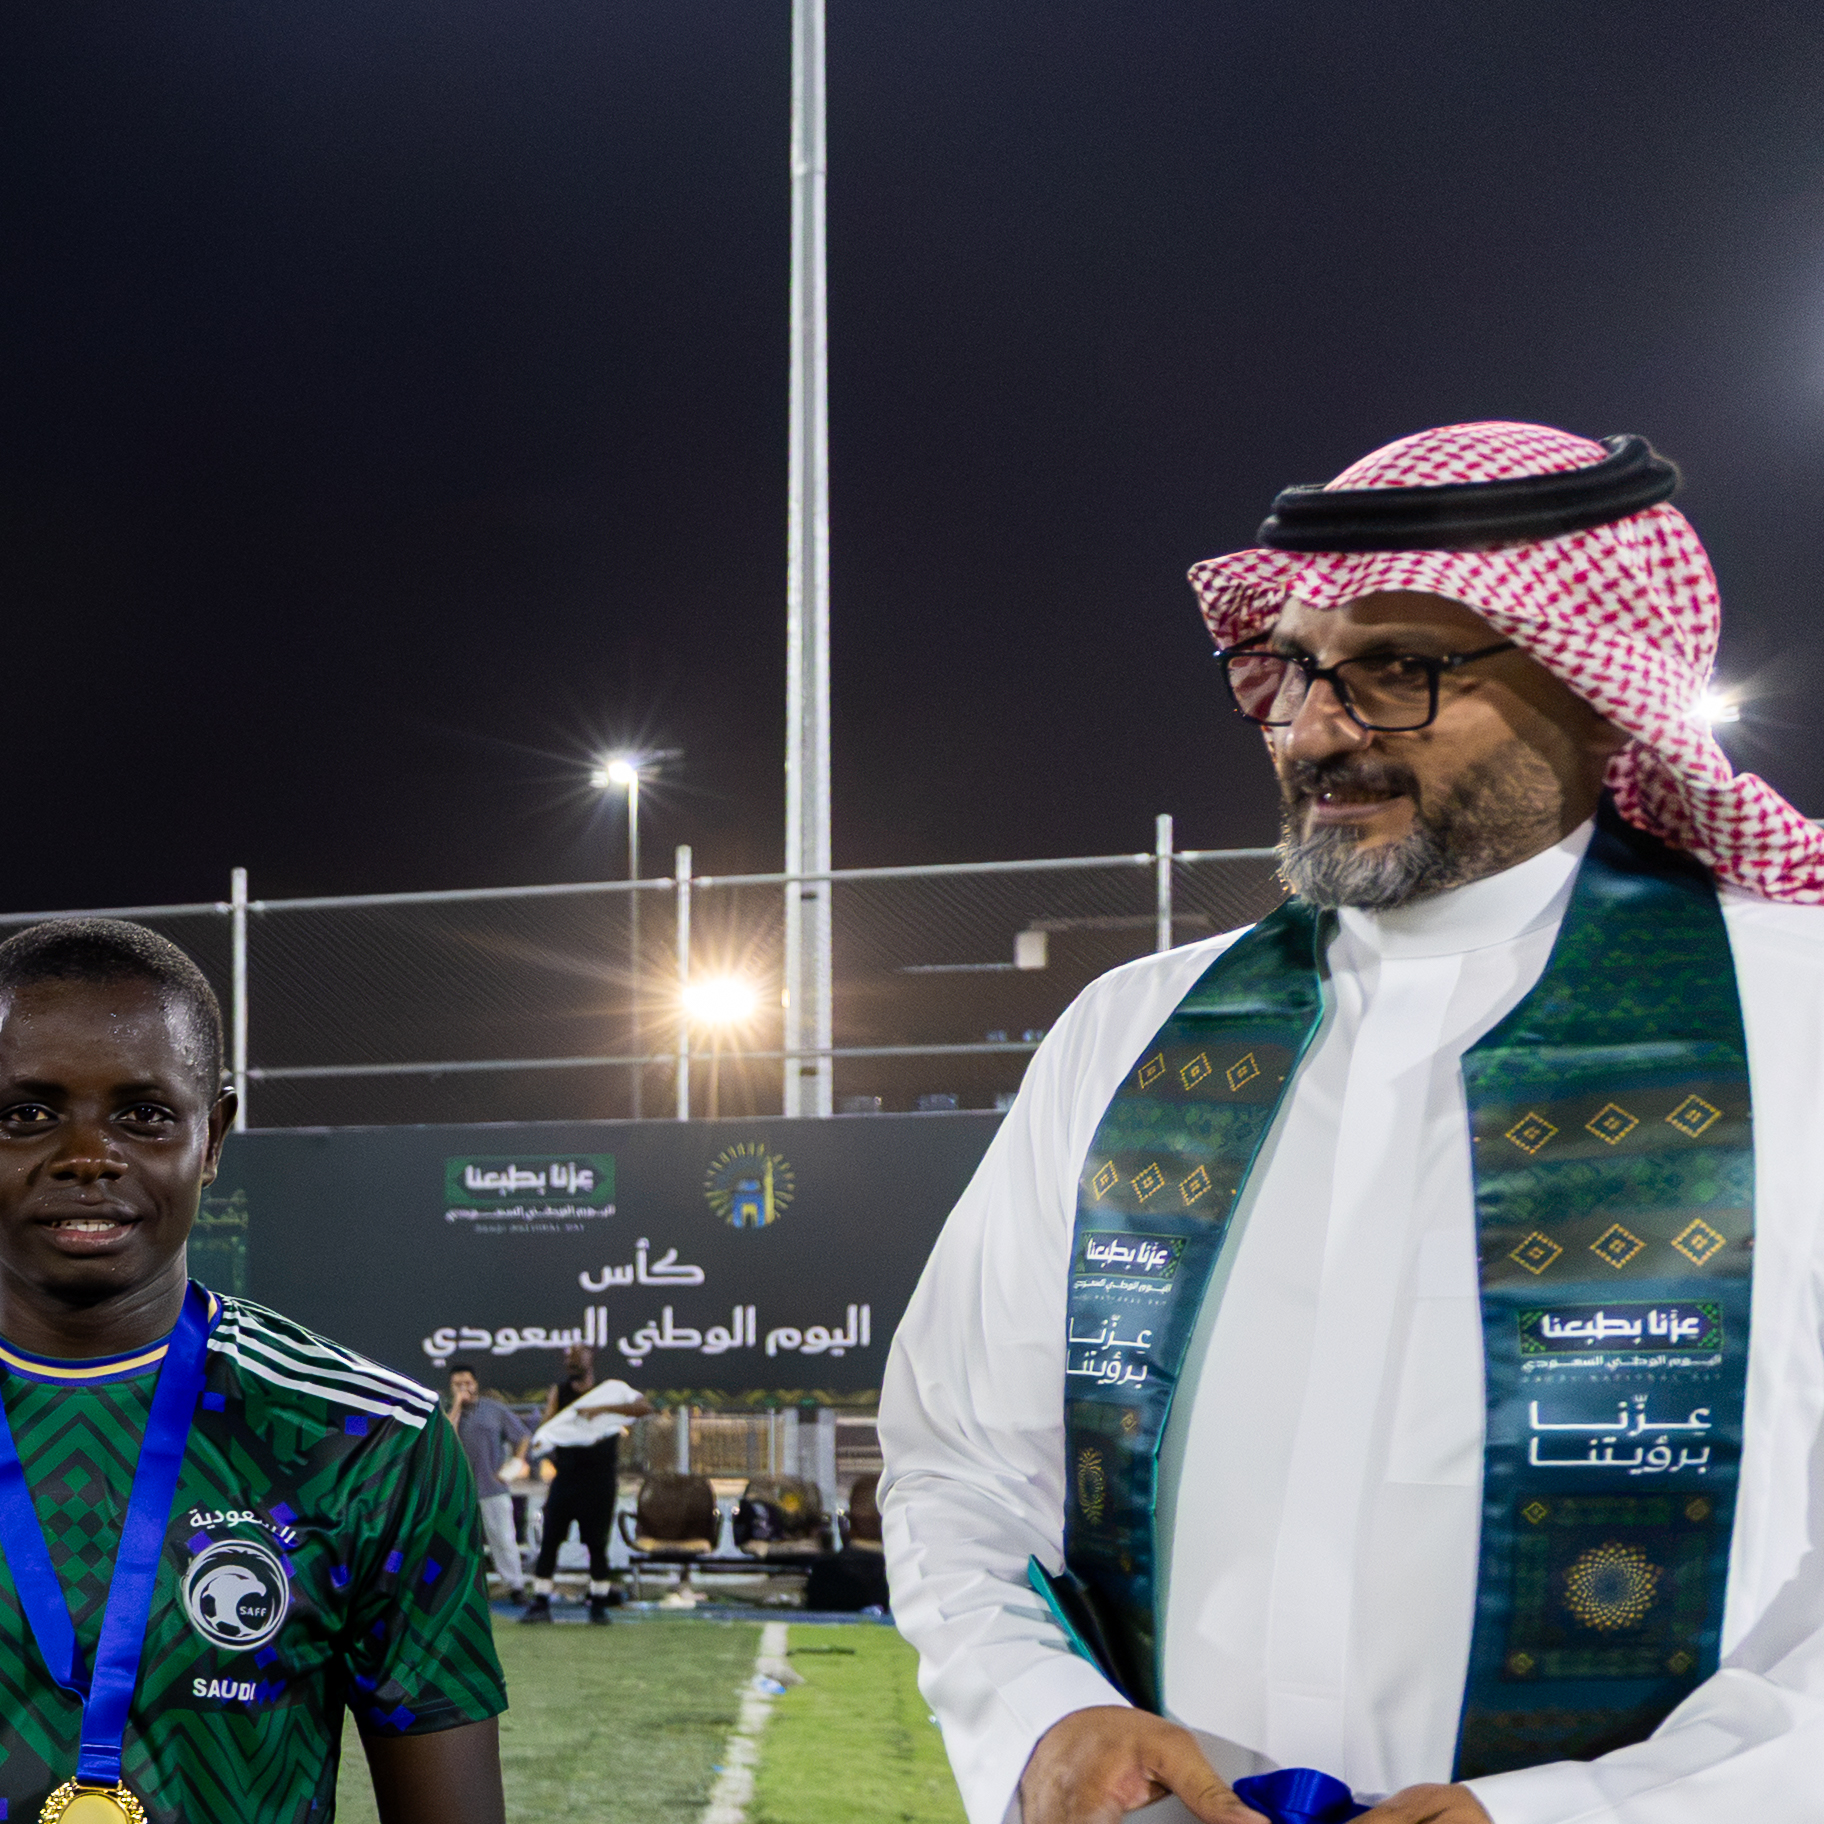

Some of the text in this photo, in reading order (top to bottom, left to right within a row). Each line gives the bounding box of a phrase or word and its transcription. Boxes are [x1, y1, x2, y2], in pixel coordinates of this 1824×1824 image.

[465, 1163, 546, 1197] بطبعنا
[578, 1237, 705, 1292] كأس
[1086, 1237, 1137, 1270] بطبعنا
[422, 1304, 871, 1367] اليوم الوطني السعودي
[1541, 1310, 1642, 1345] بطبعنا
[1066, 1350, 1148, 1389] برؤيتنا
[1529, 1434, 1711, 1476] برؤيتنا
[239, 1605, 267, 1617] SAFF
[192, 1677, 256, 1701] SAUDI
